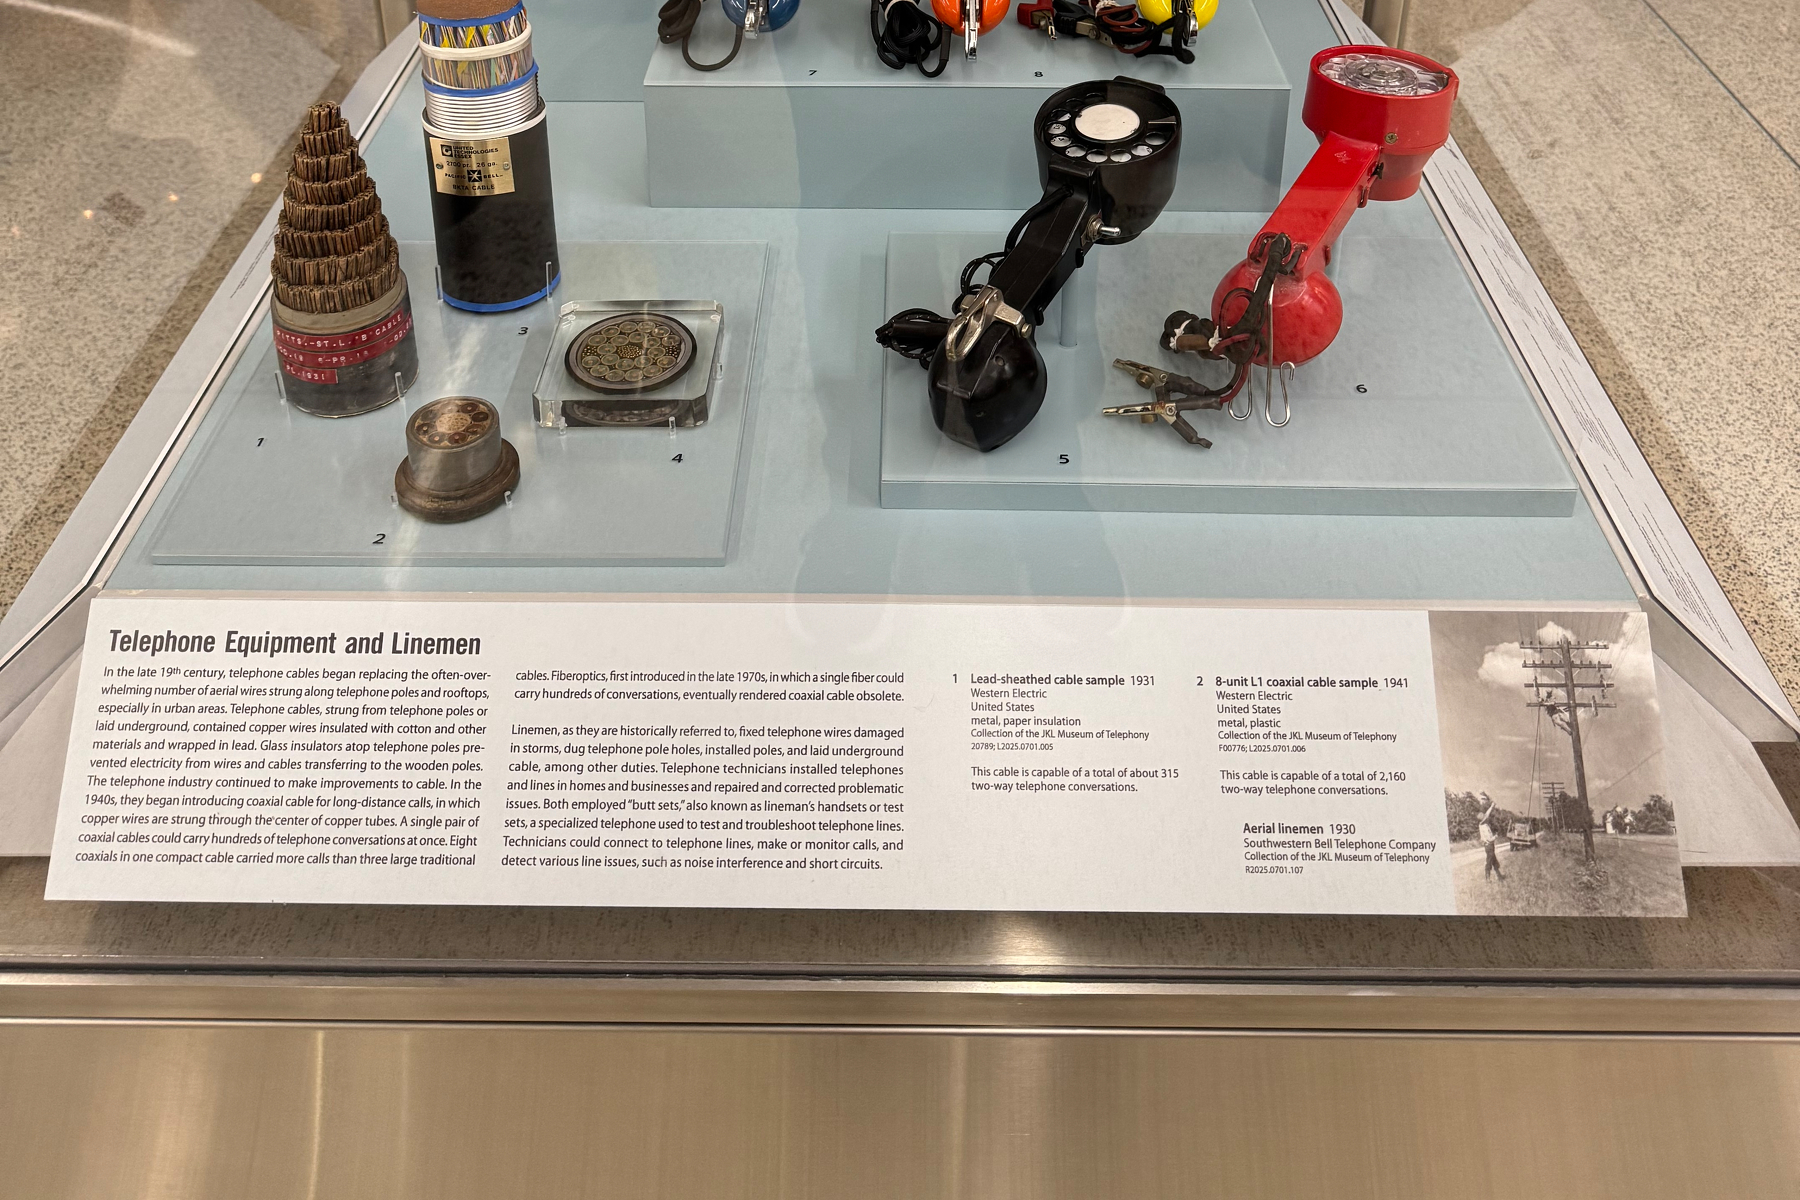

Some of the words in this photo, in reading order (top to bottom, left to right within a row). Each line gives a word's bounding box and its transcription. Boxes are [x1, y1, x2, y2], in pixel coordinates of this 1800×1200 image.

[375, 314, 402, 336] CABLE
[518, 326, 528, 335] 3
[1356, 384, 1367, 394] 6
[257, 438, 265, 447] 1
[672, 453, 684, 464] 4
[1059, 454, 1070, 465] 5
[372, 534, 386, 545] 2
[109, 629, 215, 656] Telephone
[224, 630, 336, 658] Equipment
[344, 631, 383, 654] and
[391, 632, 480, 655] Linemen
[103, 666, 113, 676] In
[117, 666, 134, 677] the
[137, 666, 156, 677] late
[161, 666, 181, 677] 19th
[183, 668, 225, 680] century,
[229, 667, 283, 680] telephone
[285, 667, 319, 678] cables
[322, 667, 355, 681] began
[358, 668, 408, 682] replacing
[411, 668, 428, 679] the
[431, 668, 491, 680] often-over-
[952, 673, 956, 683] 1
[970, 673, 1051, 685] Lead-sheathed
[1053, 674, 1083, 685] cable
[1085, 674, 1124, 688] sample
[1130, 675, 1154, 685] 1931
[1196, 675, 1203, 686] 2
[1215, 676, 1248, 686] 8-unit
[1250, 676, 1262, 686] L1
[1266, 676, 1304, 687] coaxial
[1306, 676, 1336, 687] cable
[1338, 677, 1378, 690] sample
[1383, 677, 1407, 688] 1941
[514, 690, 540, 701] carry
[542, 687, 592, 699] hundreds
[594, 687, 605, 699] of
[606, 688, 680, 701] conversations,
[682, 689, 737, 702] eventually
[738, 689, 786, 700] rendered
[788, 689, 824, 700] coaxial
[826, 689, 854, 701] cable
[856, 690, 904, 701] obsolete.
[970, 687, 1009, 698] Western
[1012, 688, 1047, 698] Electric
[1215, 690, 1255, 700] Western
[1257, 690, 1292, 701] Electric
[971, 701, 1002, 711] United
[1005, 701, 1034, 712] States
[1216, 704, 1249, 714] United
[1251, 704, 1281, 714] States
[971, 715, 1002, 727] metal,
[1003, 717, 1031, 728] paper
[1033, 716, 1080, 726] insulation
[1217, 717, 1248, 729] metal,
[1249, 717, 1281, 732] plastic
[970, 728, 1012, 737] Collection
[1014, 728, 1024, 737] of
[1025, 729, 1039, 738] the
[1040, 729, 1055, 738] JKL
[1057, 729, 1093, 738] Museum
[1095, 729, 1104, 738] of
[1105, 729, 1149, 741] Telephony
[1217, 731, 1260, 739] Collection
[1262, 730, 1271, 739] of
[1272, 731, 1287, 740] the
[1288, 731, 1303, 740] JKL
[1304, 731, 1341, 740] Museum
[1342, 731, 1352, 740] of
[1352, 731, 1397, 743] Telephony
[971, 742, 995, 751] 20789;
[996, 742, 1053, 750] L2025.0701.005
[1218, 744, 1247, 753] F00776;
[1248, 744, 1306, 752] L2025.0701.006
[970, 766, 990, 776] This
[992, 766, 1019, 777] cable
[1021, 767, 1029, 776] is
[1031, 766, 1069, 779] capable
[1072, 766, 1082, 777] of
[1084, 769, 1090, 777] a
[1092, 767, 1114, 777] total
[1117, 767, 1127, 777] of
[1129, 767, 1158, 778] about
[1161, 768, 1178, 778] 315
[1219, 769, 1240, 780] This
[1242, 769, 1268, 780] cable
[1270, 770, 1278, 780] is
[1280, 770, 1319, 782] capable
[1321, 770, 1331, 780] of
[1333, 773, 1339, 781] a
[1341, 770, 1364, 781] total
[1366, 770, 1377, 781] of
[1379, 771, 1405, 782] 2,160
[971, 782, 1013, 793] two-way
[1015, 780, 1065, 793] telephone
[1067, 782, 1137, 792] conversations.
[1220, 785, 1263, 796] two-way
[1265, 784, 1315, 796] telephone
[1317, 785, 1388, 795] conversations.
[1242, 822, 1275, 834] Aerial
[1278, 822, 1323, 834] linemen
[1329, 823, 1355, 834] 1930
[1243, 837, 1311, 848] Southwestern
[1314, 838, 1332, 849] Bell
[1334, 839, 1386, 850] Telephone
[1388, 839, 1436, 853] Company
[1244, 851, 1288, 861] Collection
[1290, 851, 1299, 861] of
[1300, 851, 1315, 861] the
[1317, 852, 1332, 861] JKL
[1334, 852, 1372, 861] Museum
[1373, 852, 1383, 861] of
[1383, 853, 1430, 864] Telephony
[1245, 865, 1303, 874] R2025.0701.107
